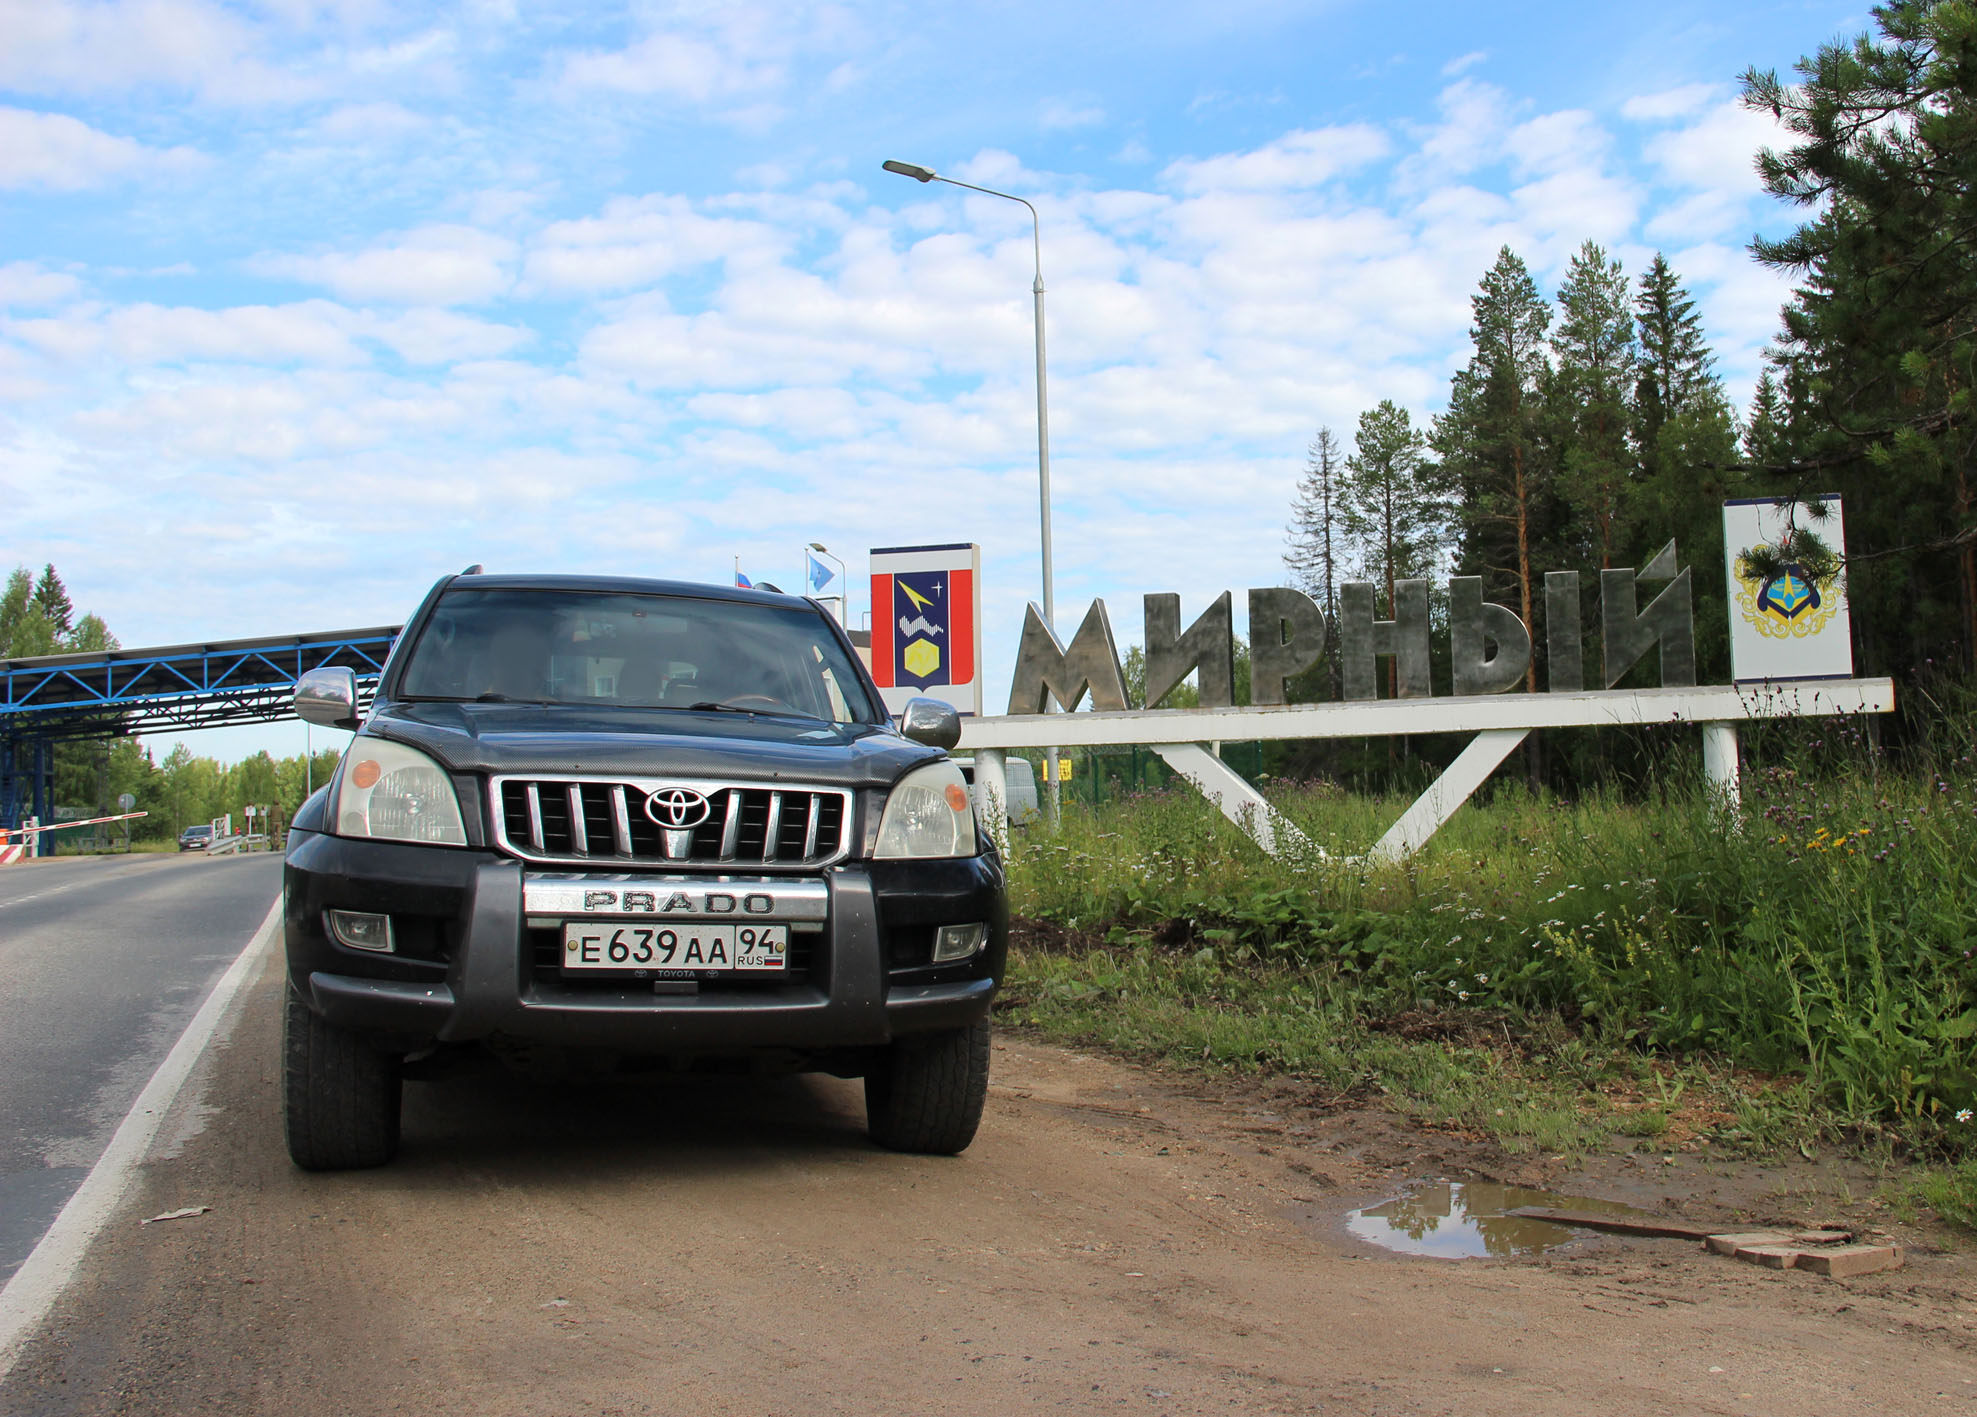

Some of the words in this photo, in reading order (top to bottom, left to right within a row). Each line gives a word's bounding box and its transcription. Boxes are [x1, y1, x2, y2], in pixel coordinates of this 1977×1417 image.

[1007, 538, 1696, 715] МИРНЫЙ
[585, 890, 775, 914] PRADO
[739, 928, 774, 955] 94
[737, 956, 764, 966] RUS
[658, 969, 696, 979] TOYOTA
